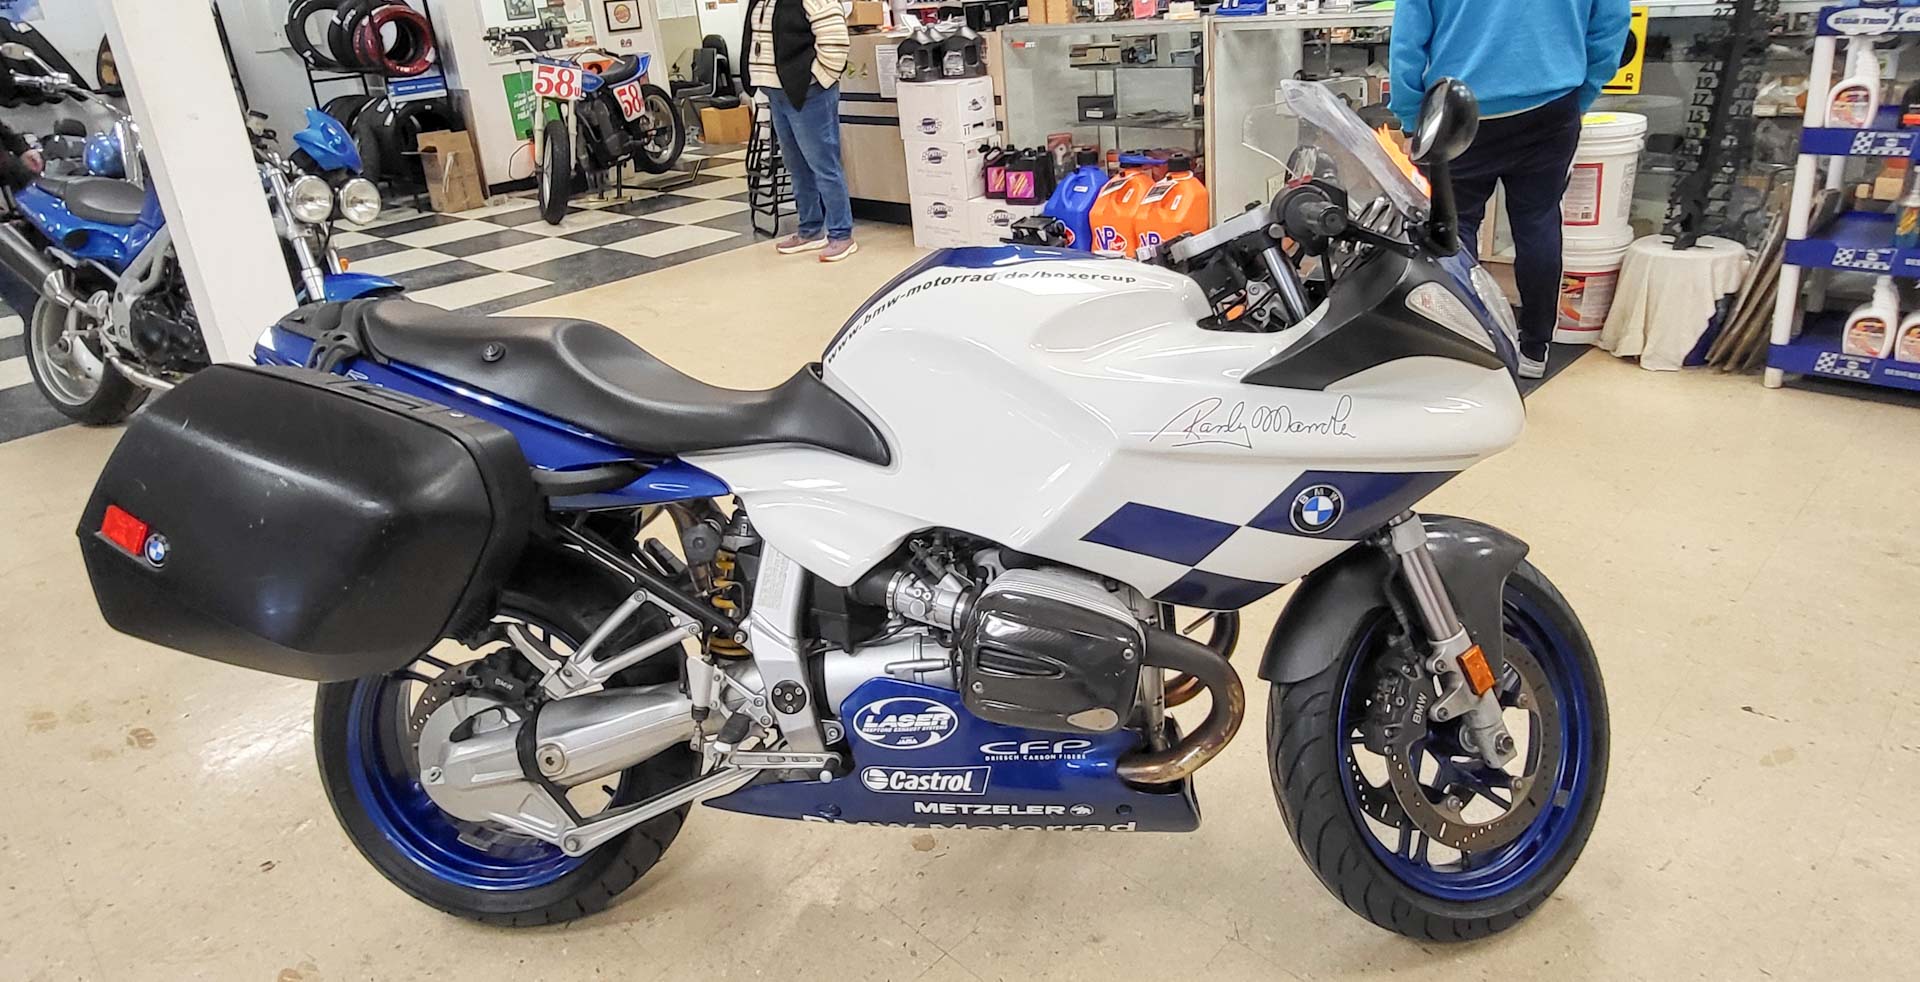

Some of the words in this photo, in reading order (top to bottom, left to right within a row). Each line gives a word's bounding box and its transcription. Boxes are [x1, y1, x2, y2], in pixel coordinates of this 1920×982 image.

[534, 65, 575, 98] 58
[1625, 73, 1633, 83] R
[617, 83, 642, 118] 58
[1693, 93, 1708, 105] 17
[1689, 110, 1703, 122] 15
[1095, 227, 1115, 250] VP
[827, 271, 1137, 364] www.bmw-motorrad.de/boxercup
[1298, 487, 1339, 505] BMW
[494, 677, 514, 691] BMW
[1412, 692, 1428, 725] BMW
[863, 712, 951, 728] LASER
[979, 739, 1092, 755] CFP
[888, 770, 973, 792] Castrol
[913, 801, 1066, 816] METZELER
